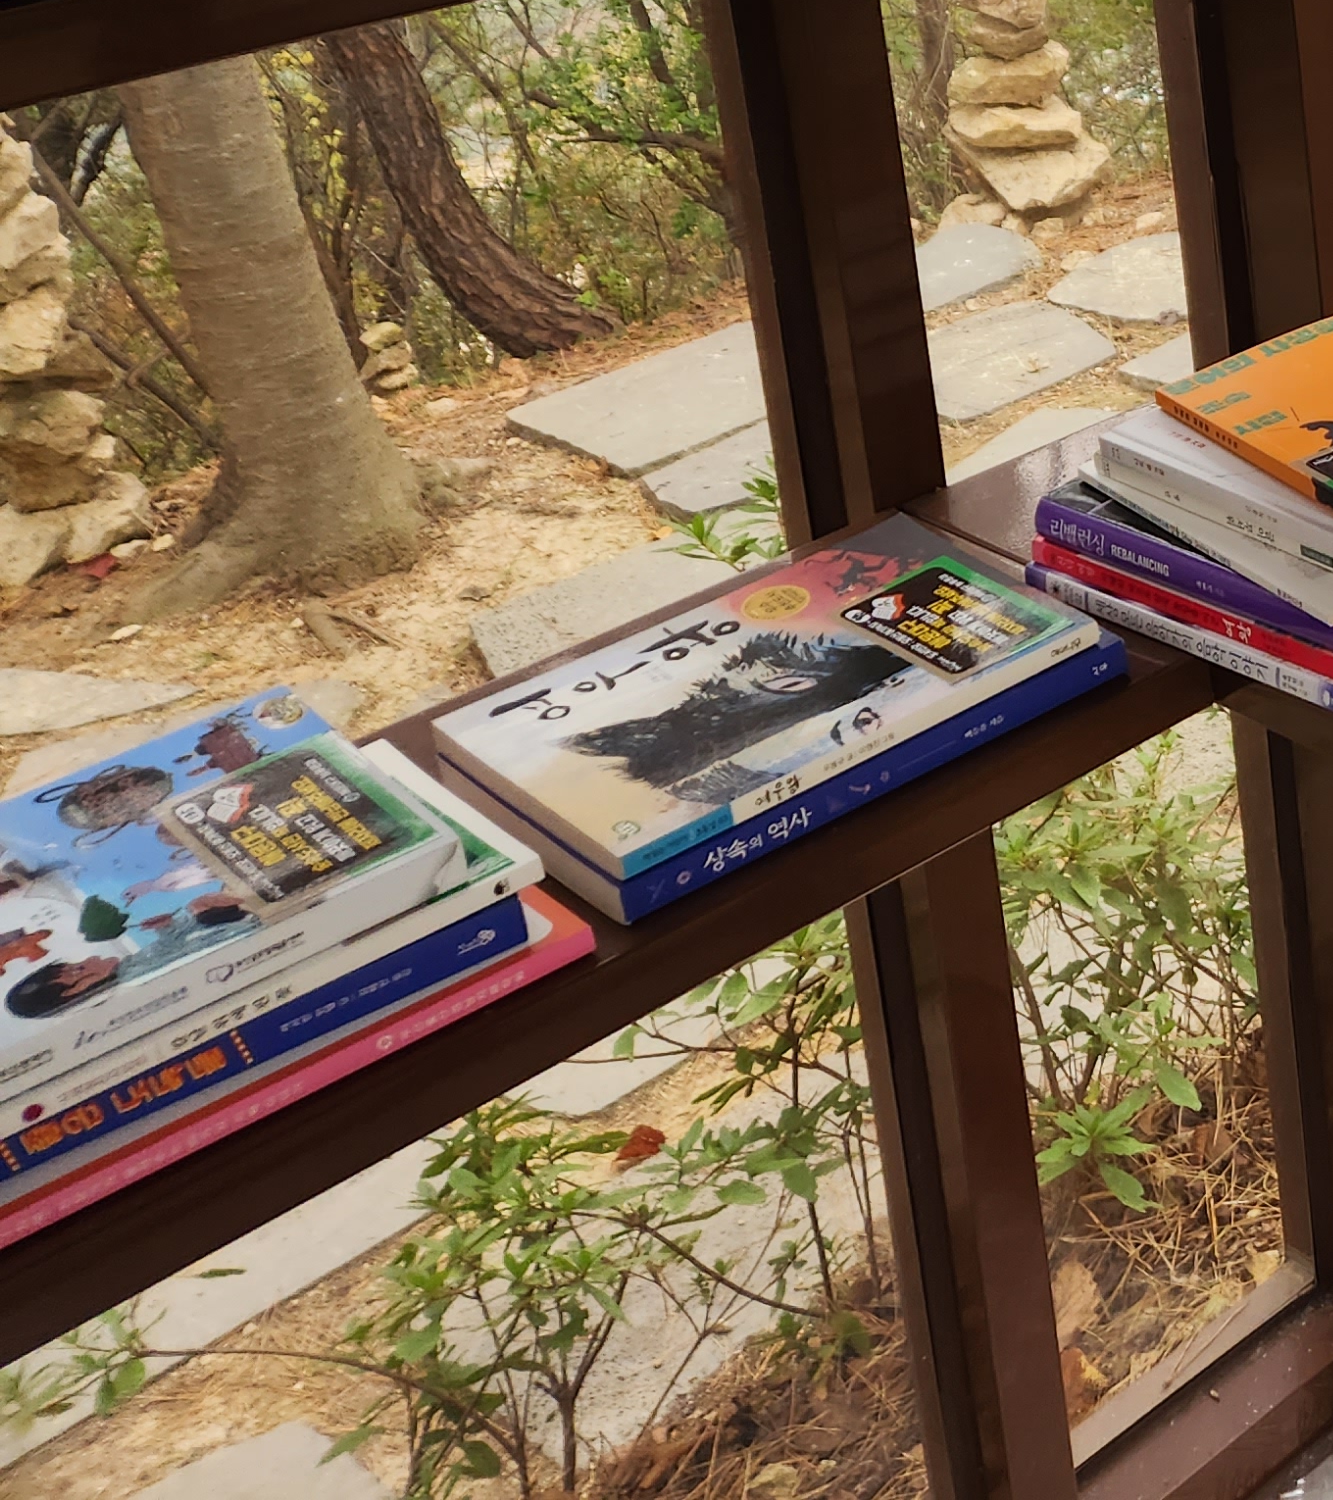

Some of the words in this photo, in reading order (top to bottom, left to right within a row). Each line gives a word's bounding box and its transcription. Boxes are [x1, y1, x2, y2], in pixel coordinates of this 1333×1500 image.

[1050, 519, 1106, 557] 리밸런싱
[1111, 546, 1170, 577] REBALANCING
[1146, 617, 1194, 652] 음악가의
[1196, 636, 1226, 665] 음악
[1229, 647, 1269, 682] 이야기
[703, 832, 764, 873] 상속의
[767, 806, 813, 846] 역사
